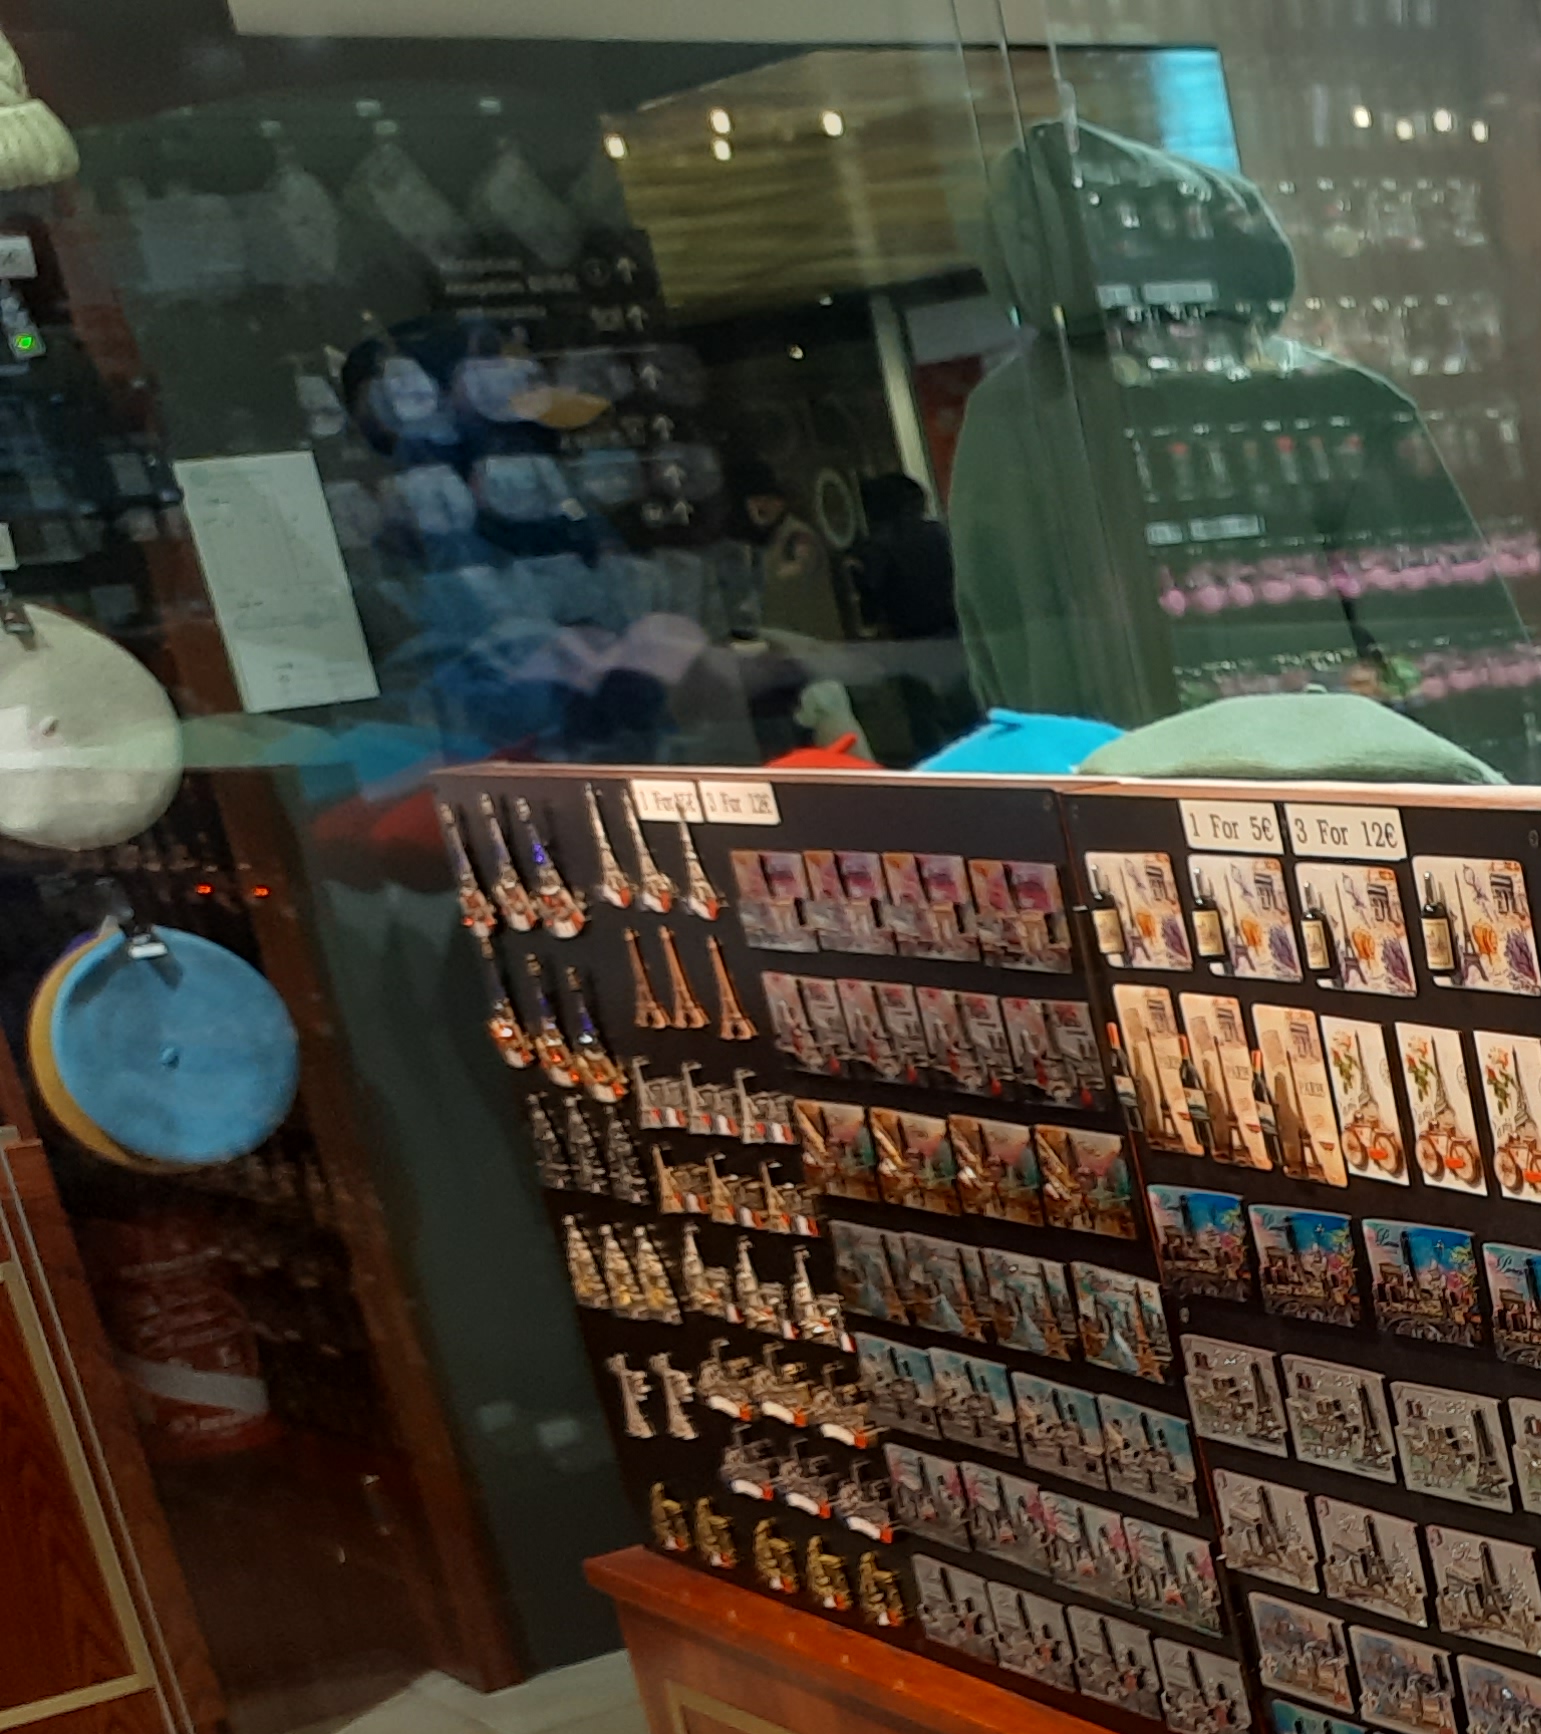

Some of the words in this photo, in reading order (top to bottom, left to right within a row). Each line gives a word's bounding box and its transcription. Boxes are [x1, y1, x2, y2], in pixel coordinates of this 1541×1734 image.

[1189, 812, 1201, 838] 1
[1209, 813, 1240, 840] For
[1250, 815, 1275, 842] 5€
[1294, 817, 1308, 844] 3
[1316, 818, 1349, 846] For
[1360, 820, 1398, 849] 12€
